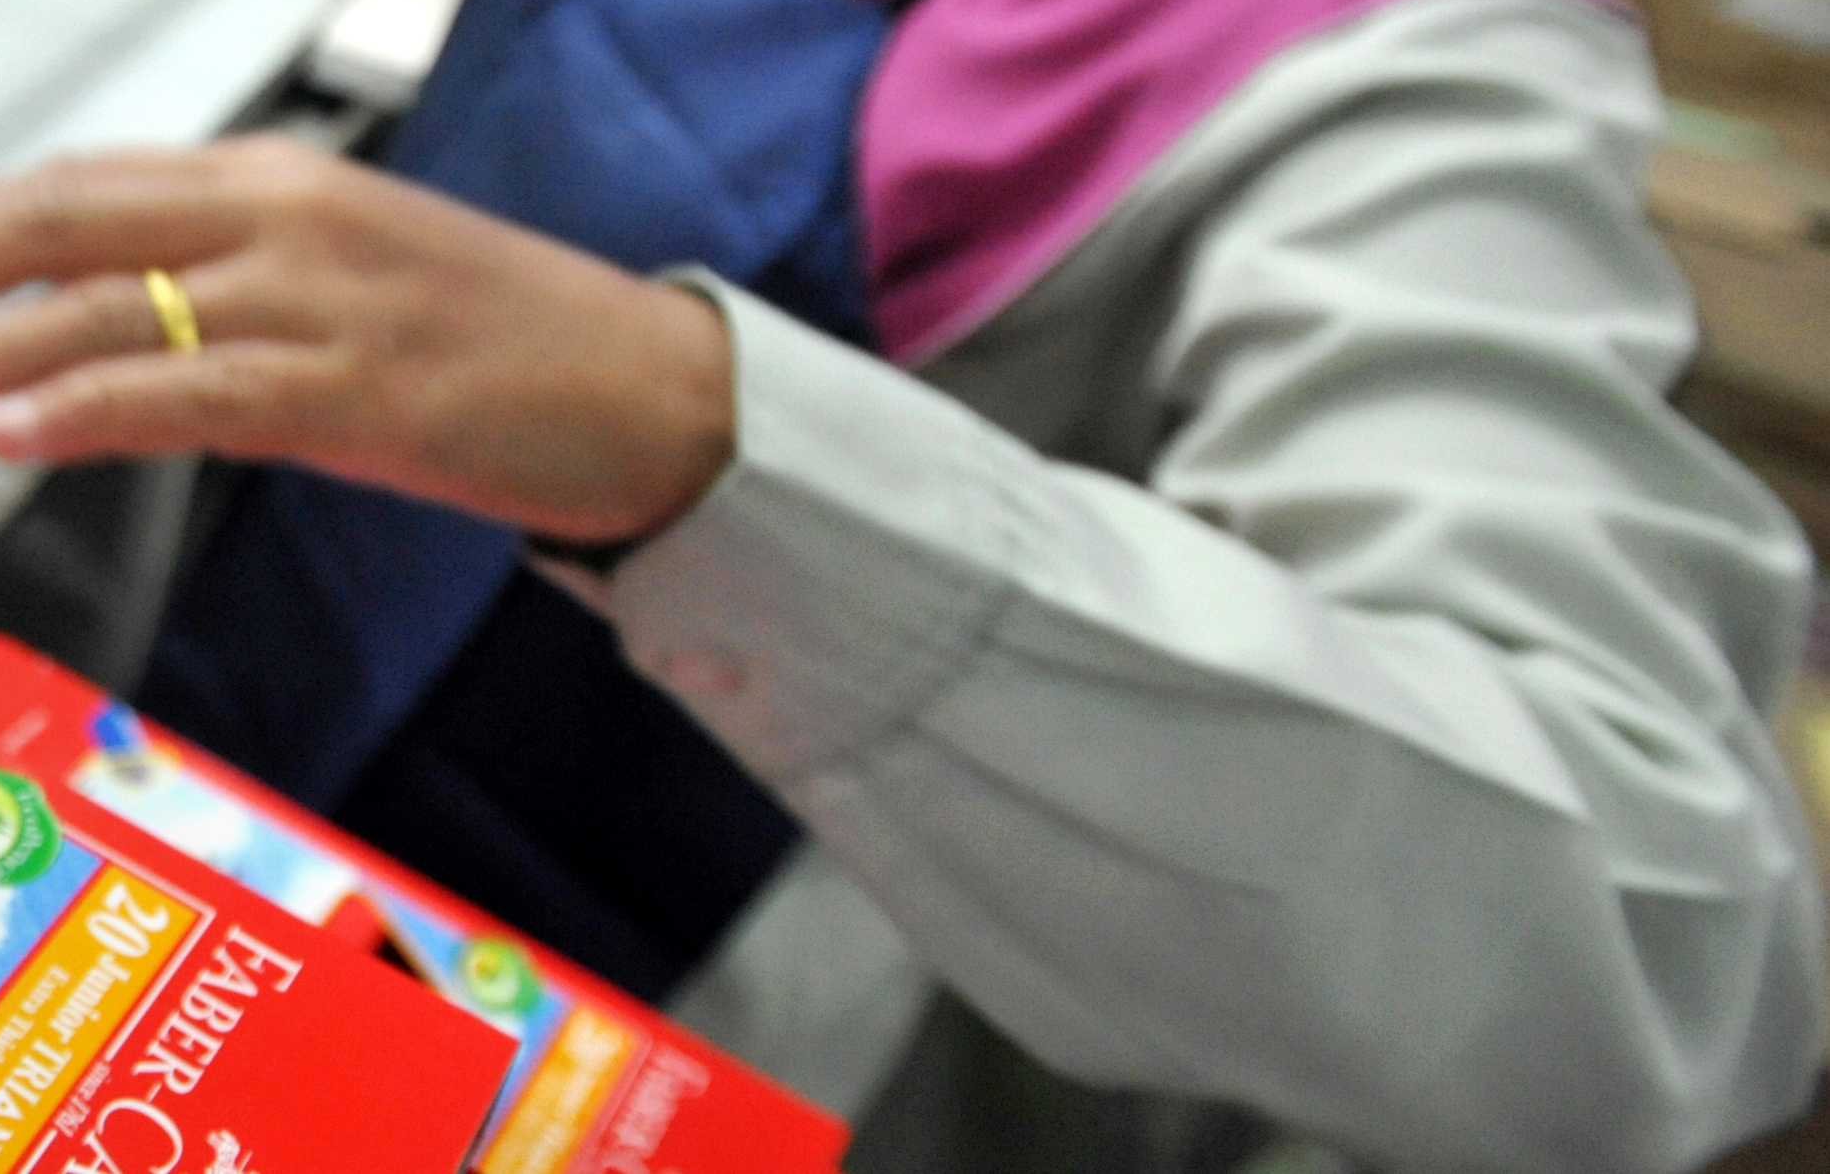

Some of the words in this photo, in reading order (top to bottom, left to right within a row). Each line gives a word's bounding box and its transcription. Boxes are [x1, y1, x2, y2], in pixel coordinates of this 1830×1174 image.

[86, 882, 170, 958] 20
[21, 965, 71, 1014] Extra
[50, 953, 132, 1044] Junior
[77, 1061, 112, 1102] since
[54, 1096, 91, 1138] 1761
